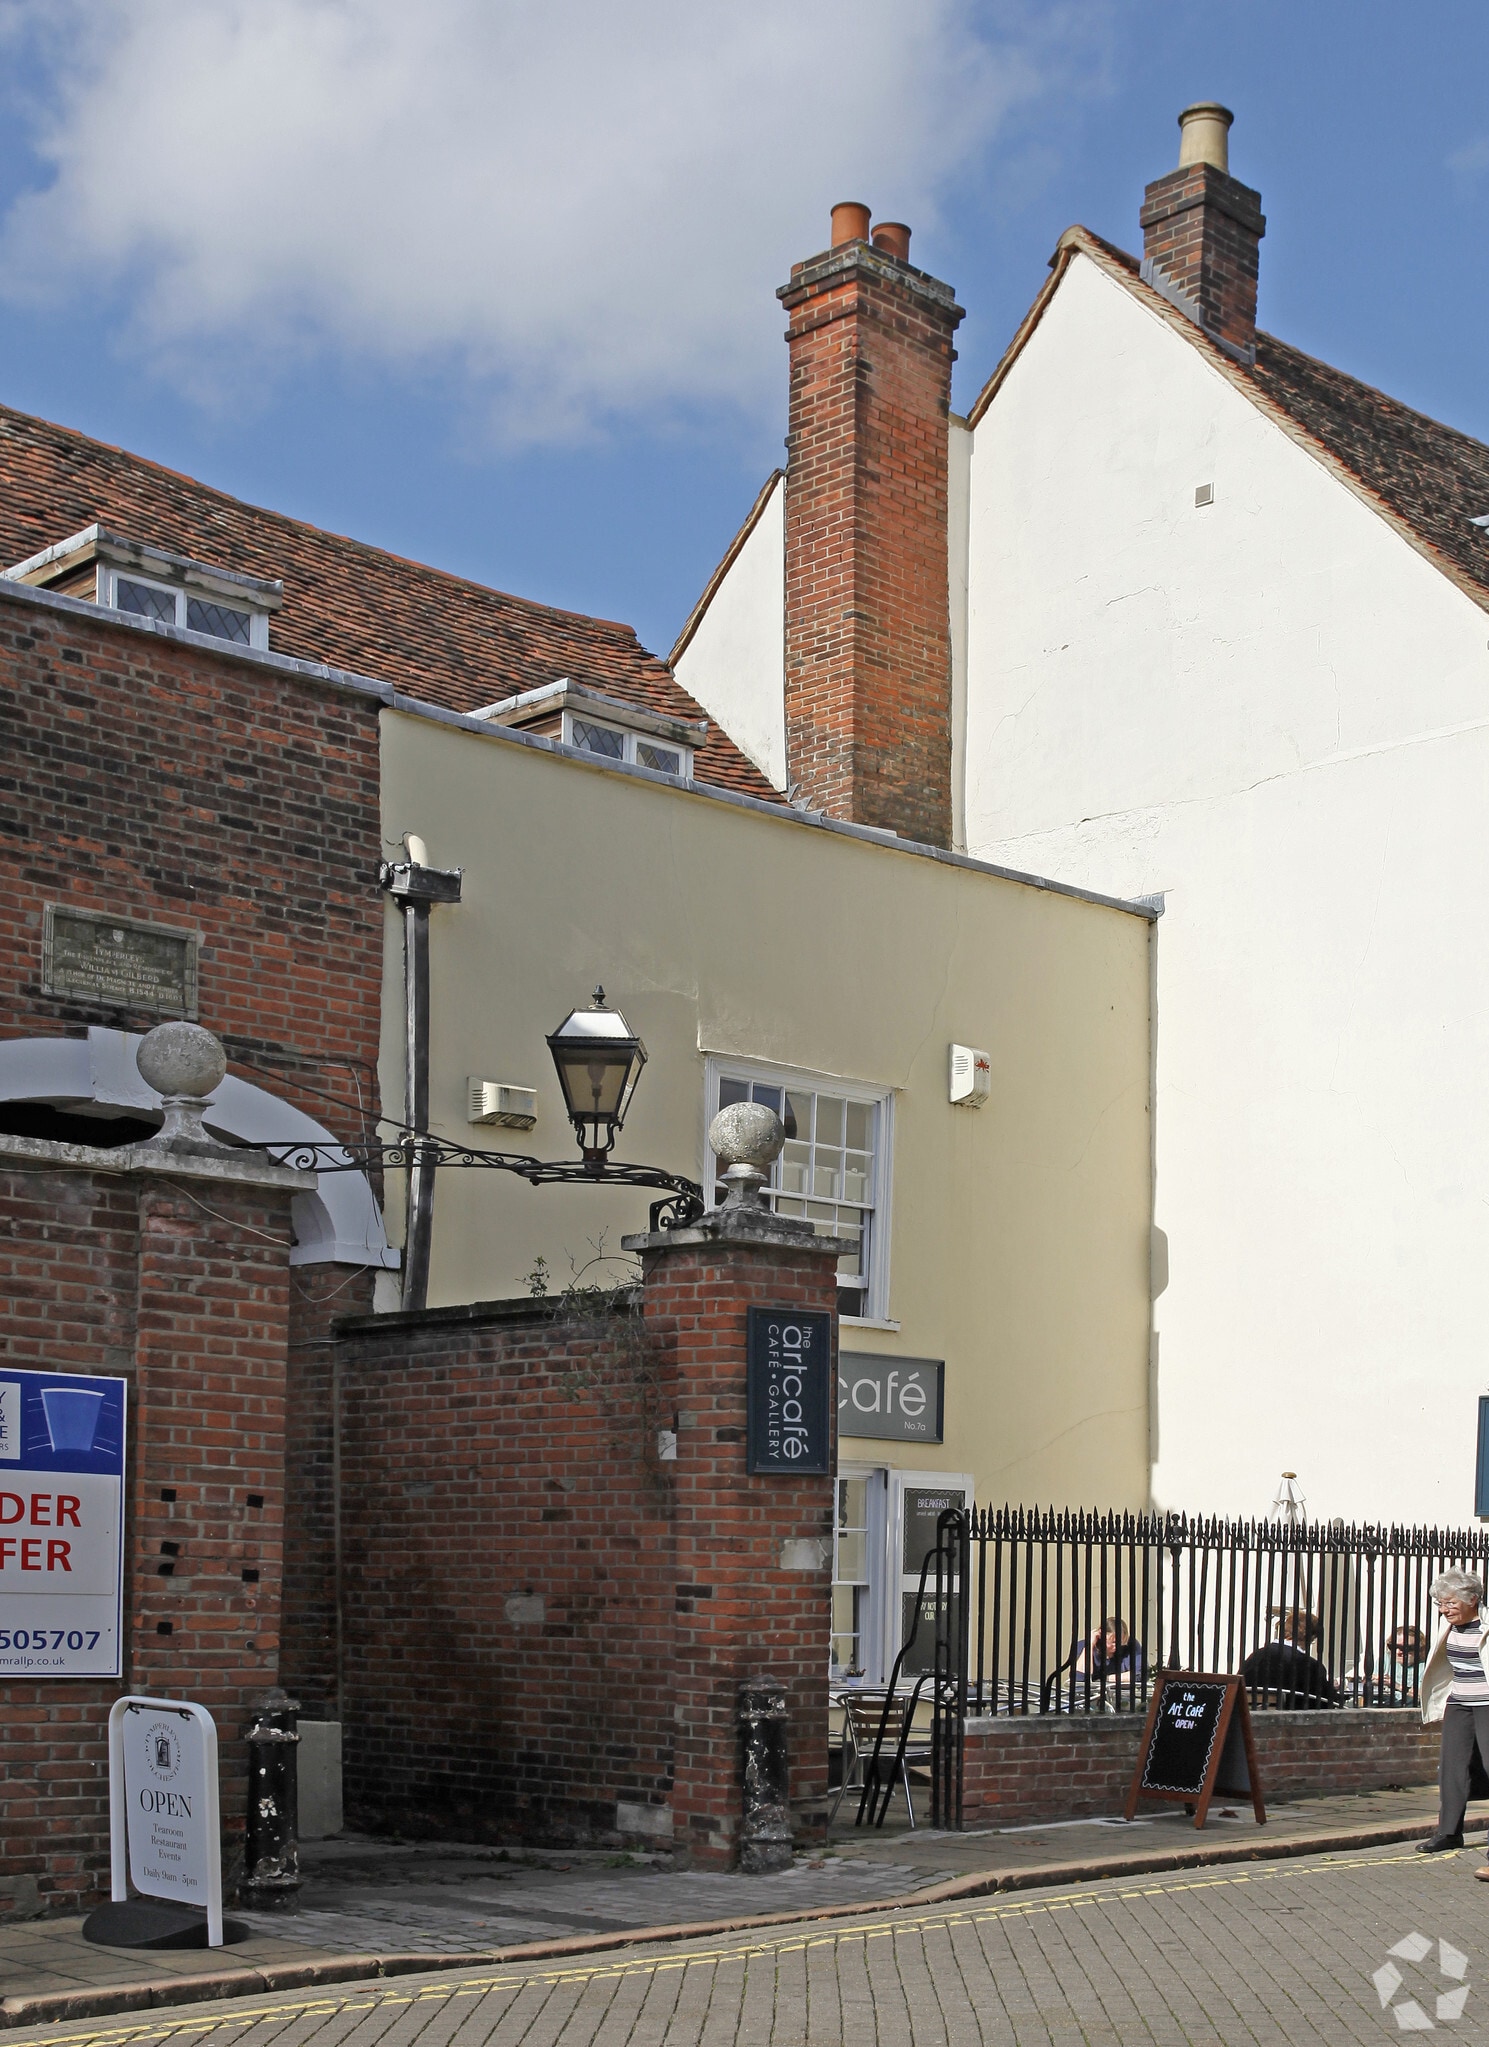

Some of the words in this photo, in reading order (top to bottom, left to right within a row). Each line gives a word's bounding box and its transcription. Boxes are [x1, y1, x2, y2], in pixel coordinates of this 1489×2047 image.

[58, 967, 86, 978] ATHOR
[80, 960, 119, 976] WILLIAM
[120, 969, 160, 984] GILBERD
[802, 1325, 814, 1349] the
[768, 1324, 782, 1368] CAFÉ
[782, 1325, 810, 1459] artcafé
[768, 1384, 780, 1459] GALLERY
[917, 1498, 951, 1508] BREAKFAST
[1183, 1692, 1195, 1701] the
[1167, 1702, 1183, 1716] Art
[1185, 1703, 1207, 1717] Café
[140, 1788, 192, 1818] OPEN
[153, 1823, 184, 1838] Tearoom
[151, 1835, 187, 1850] Restaurant
[158, 1849, 181, 1861] Events
[143, 1866, 160, 1880] Daily
[161, 1869, 177, 1881] 9am
[182, 1873, 197, 1886] 5pm
